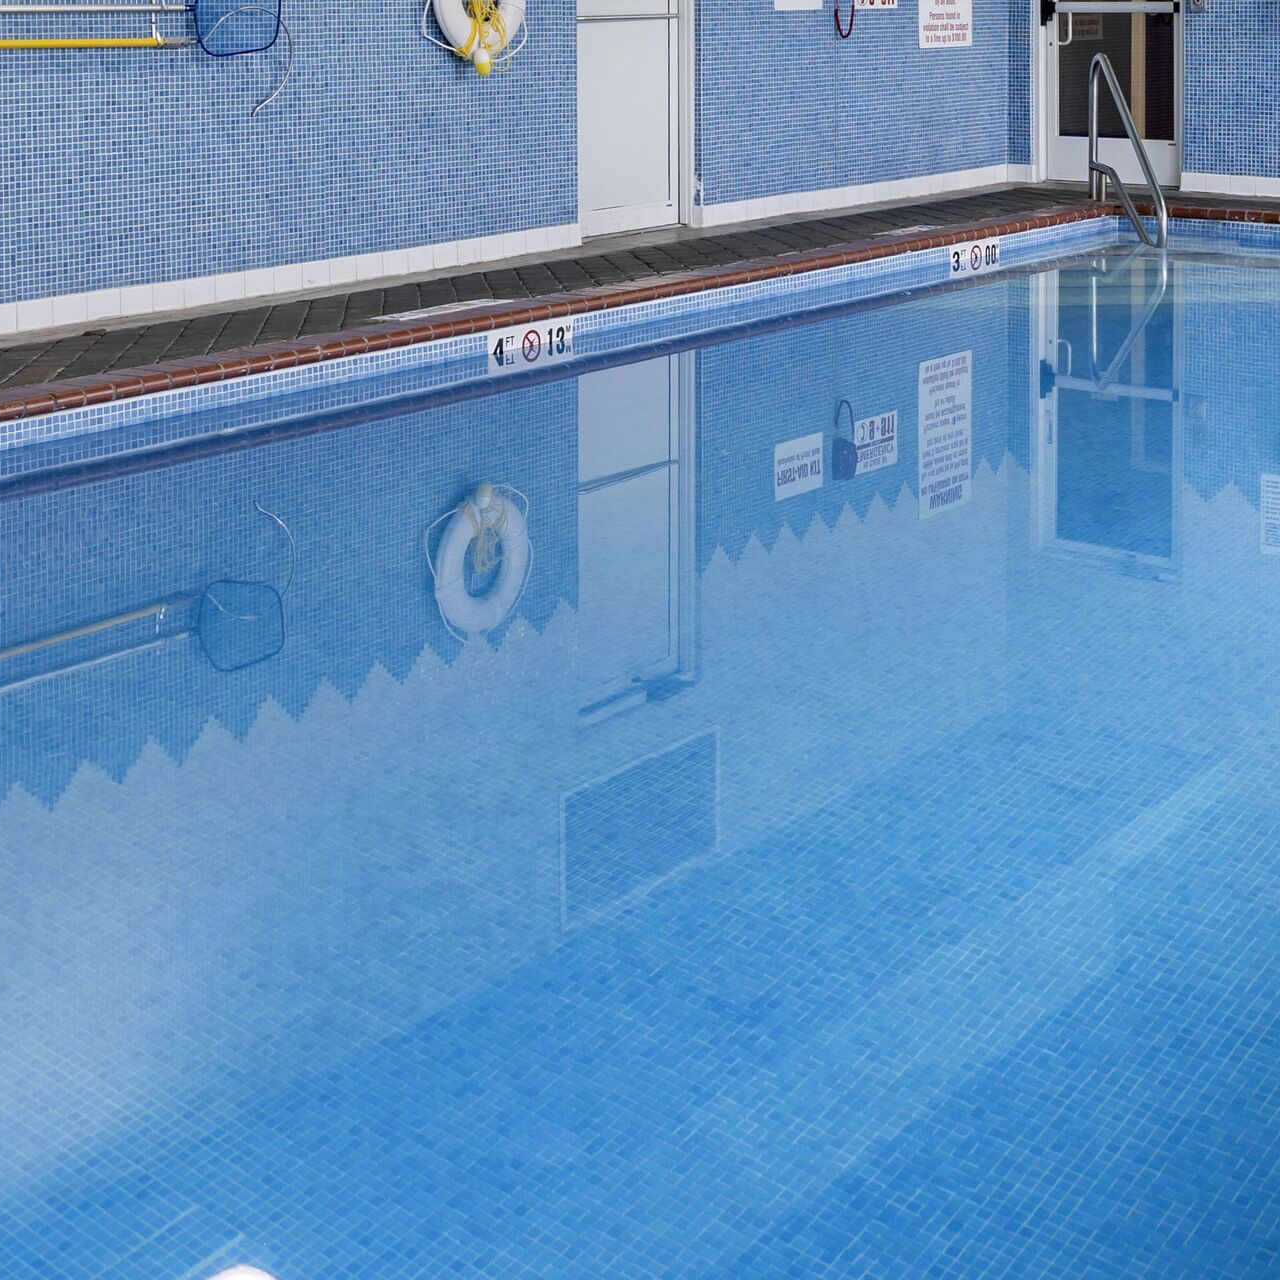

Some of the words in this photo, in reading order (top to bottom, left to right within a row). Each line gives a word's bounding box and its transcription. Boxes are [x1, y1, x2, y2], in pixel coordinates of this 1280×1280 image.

[929, 11, 944, 20] Persons
[945, 11, 956, 19] found
[923, 23, 939, 31] violation
[940, 23, 949, 31] shall
[950, 23, 954, 31] be
[955, 23, 968, 31] subject
[942, 35, 946, 43] up
[947, 34, 951, 42] to
[952, 251, 960, 272] 3
[505, 335, 515, 347] FT
